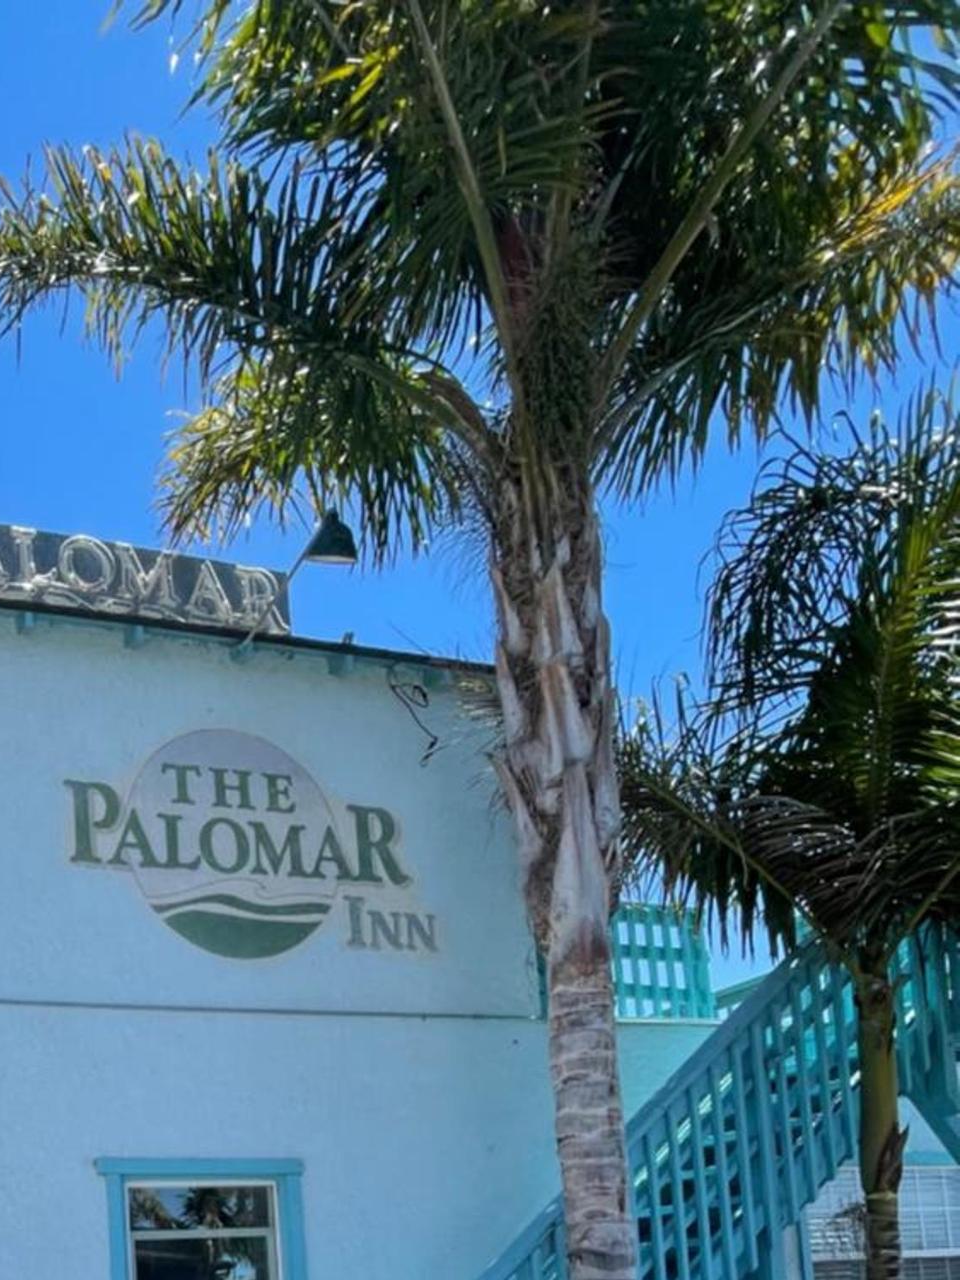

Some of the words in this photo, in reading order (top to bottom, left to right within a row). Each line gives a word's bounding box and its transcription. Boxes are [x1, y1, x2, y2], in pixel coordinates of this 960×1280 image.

[161, 762, 296, 813] THE
[63, 778, 413, 886] PALOMAR
[342, 895, 439, 953] INN
